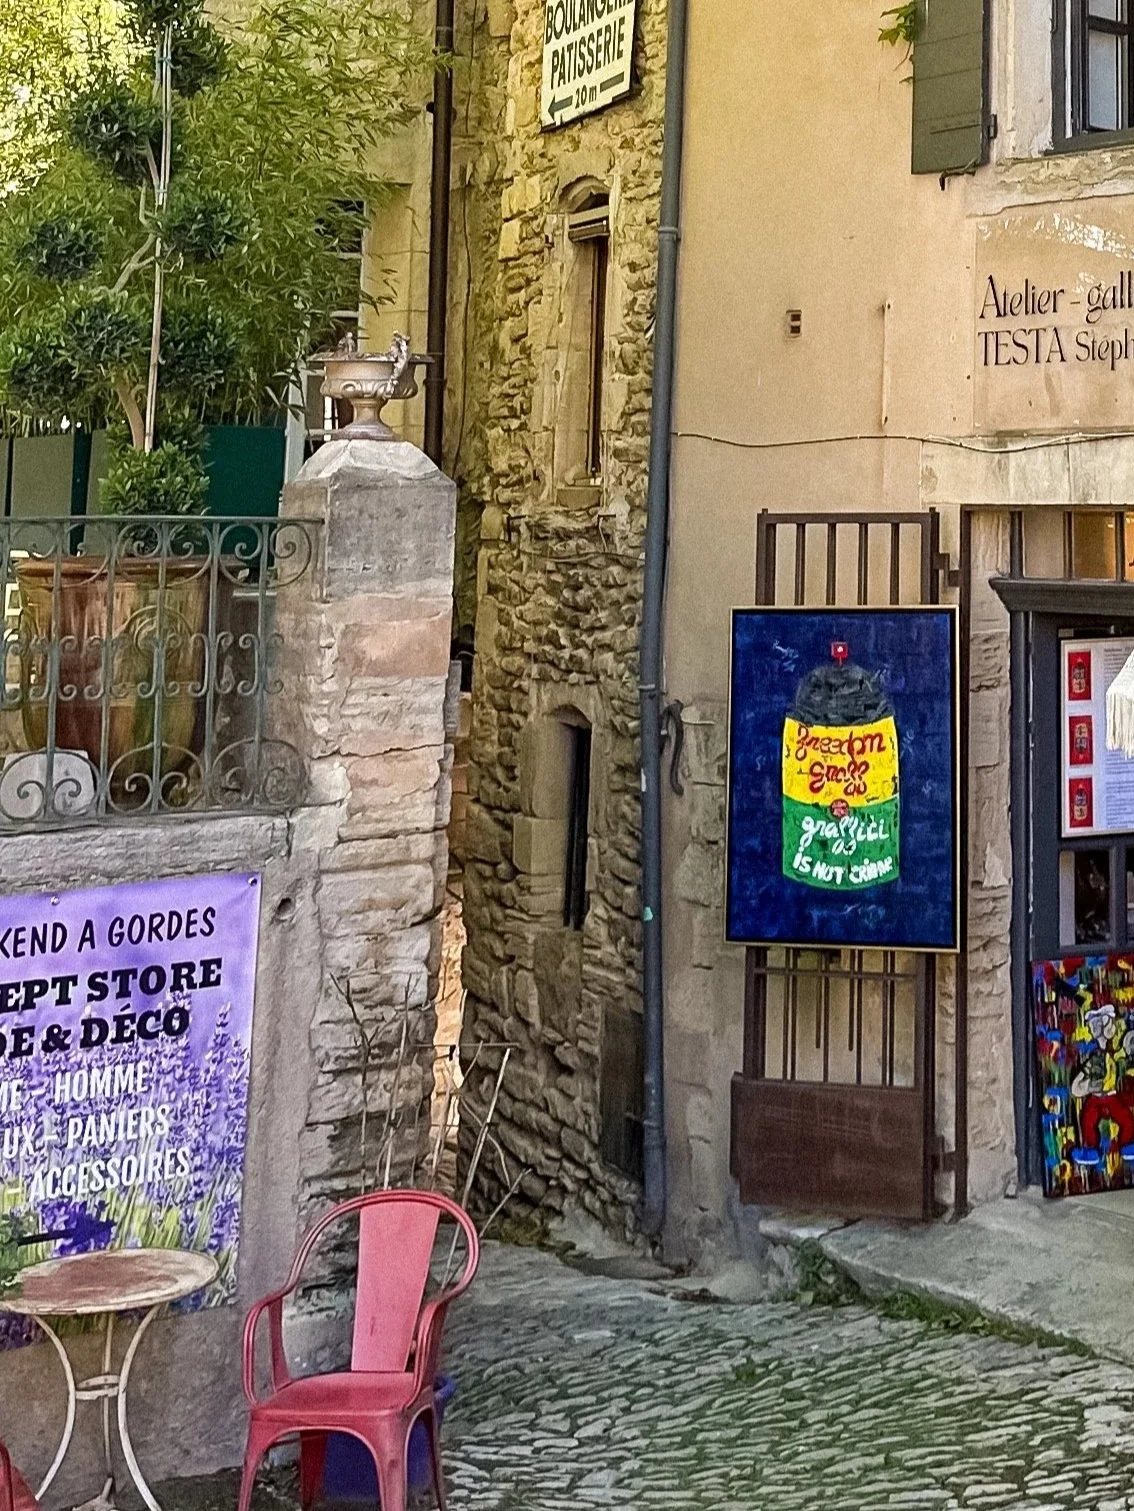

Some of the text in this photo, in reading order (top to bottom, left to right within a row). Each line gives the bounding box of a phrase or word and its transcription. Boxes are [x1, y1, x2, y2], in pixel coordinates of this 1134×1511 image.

[550, 15, 626, 91] PATISSERIE
[978, 274, 1065, 320] Atelier
[977, 326, 1067, 366] TESTA
[77, 918, 96, 953] A
[107, 906, 216, 948] GORDES
[86, 957, 223, 1004] STORE
[41, 1023, 72, 1054] &
[79, 1002, 190, 1050] DÉCO
[54, 1061, 149, 1105] HOMME
[66, 1103, 171, 1150] PANIERS
[29, 1147, 191, 1204] ACCESSOIRES
